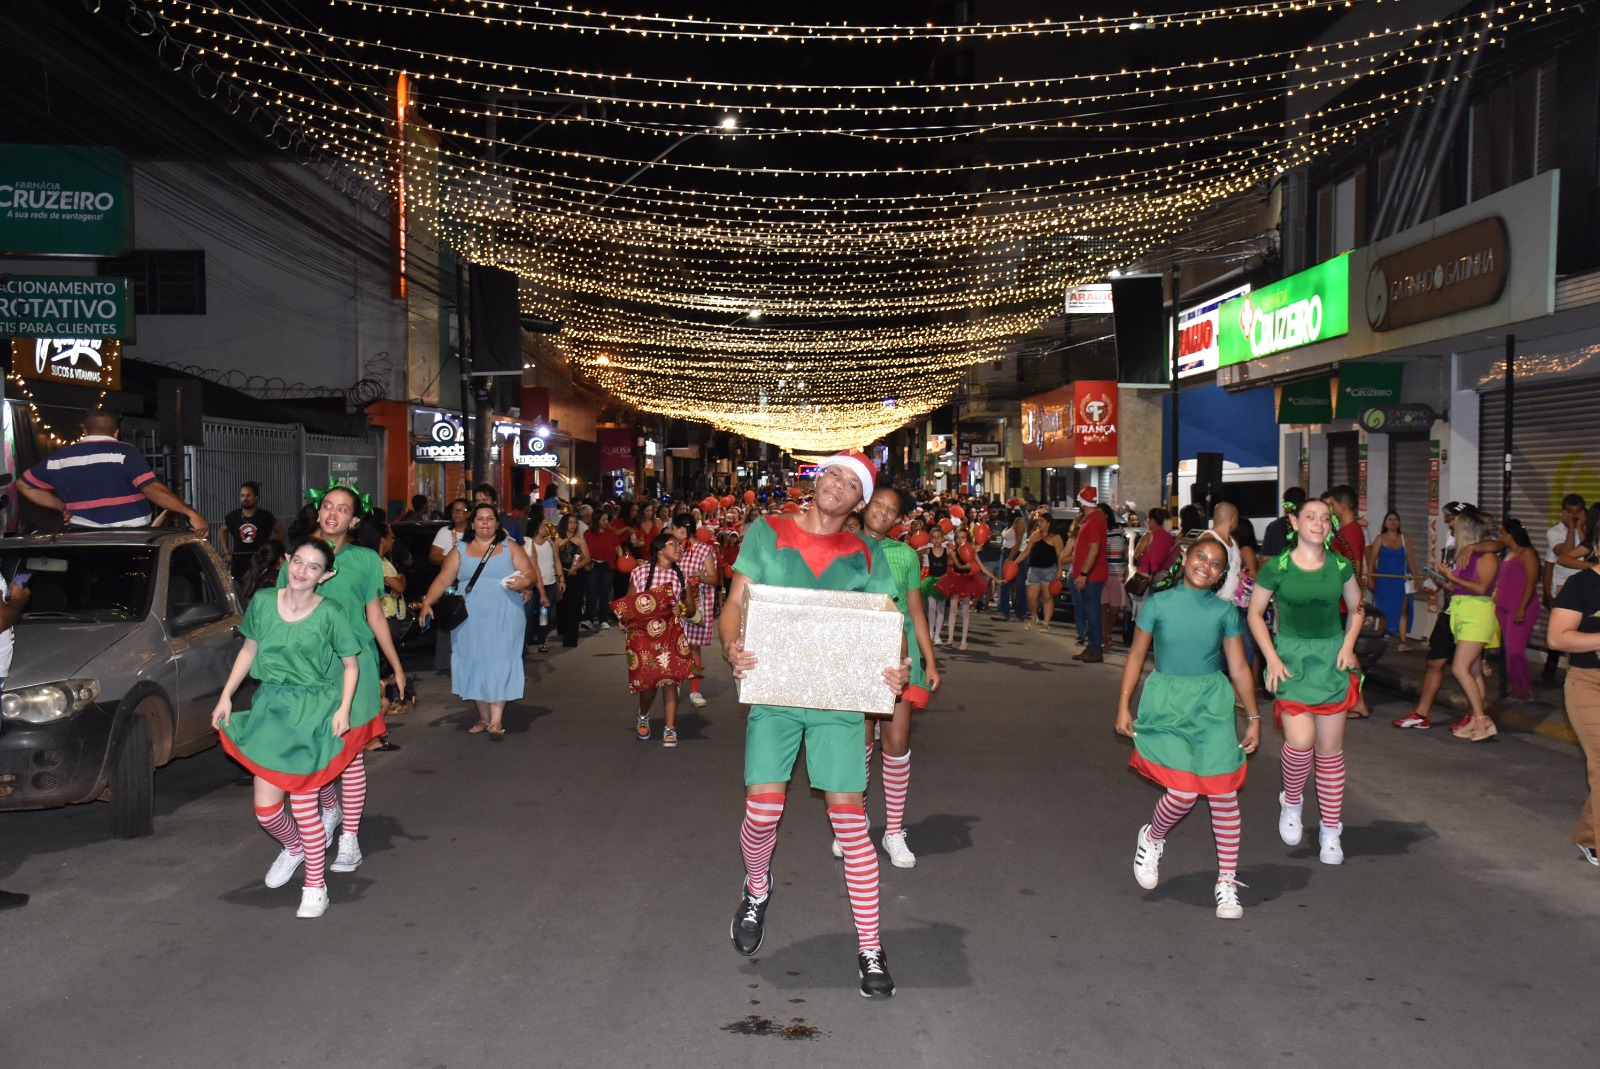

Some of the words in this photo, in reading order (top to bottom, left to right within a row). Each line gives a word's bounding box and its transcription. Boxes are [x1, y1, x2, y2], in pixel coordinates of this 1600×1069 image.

[15, 181, 60, 190] FARMÁCIA
[0, 185, 114, 211] CRUZEIRO
[31, 211, 48, 219] rede
[50, 211, 60, 219] de
[62, 213, 104, 221] vantagens!
[0, 281, 116, 295] CIONAMENTO
[0, 298, 117, 319] ROTATIVO
[20, 322, 54, 333] PARA
[56, 323, 117, 335] CLIENTES
[51, 364, 69, 378] SUCOS
[69, 367, 74, 378] &
[1076, 424, 1117, 436] FRANÇA
